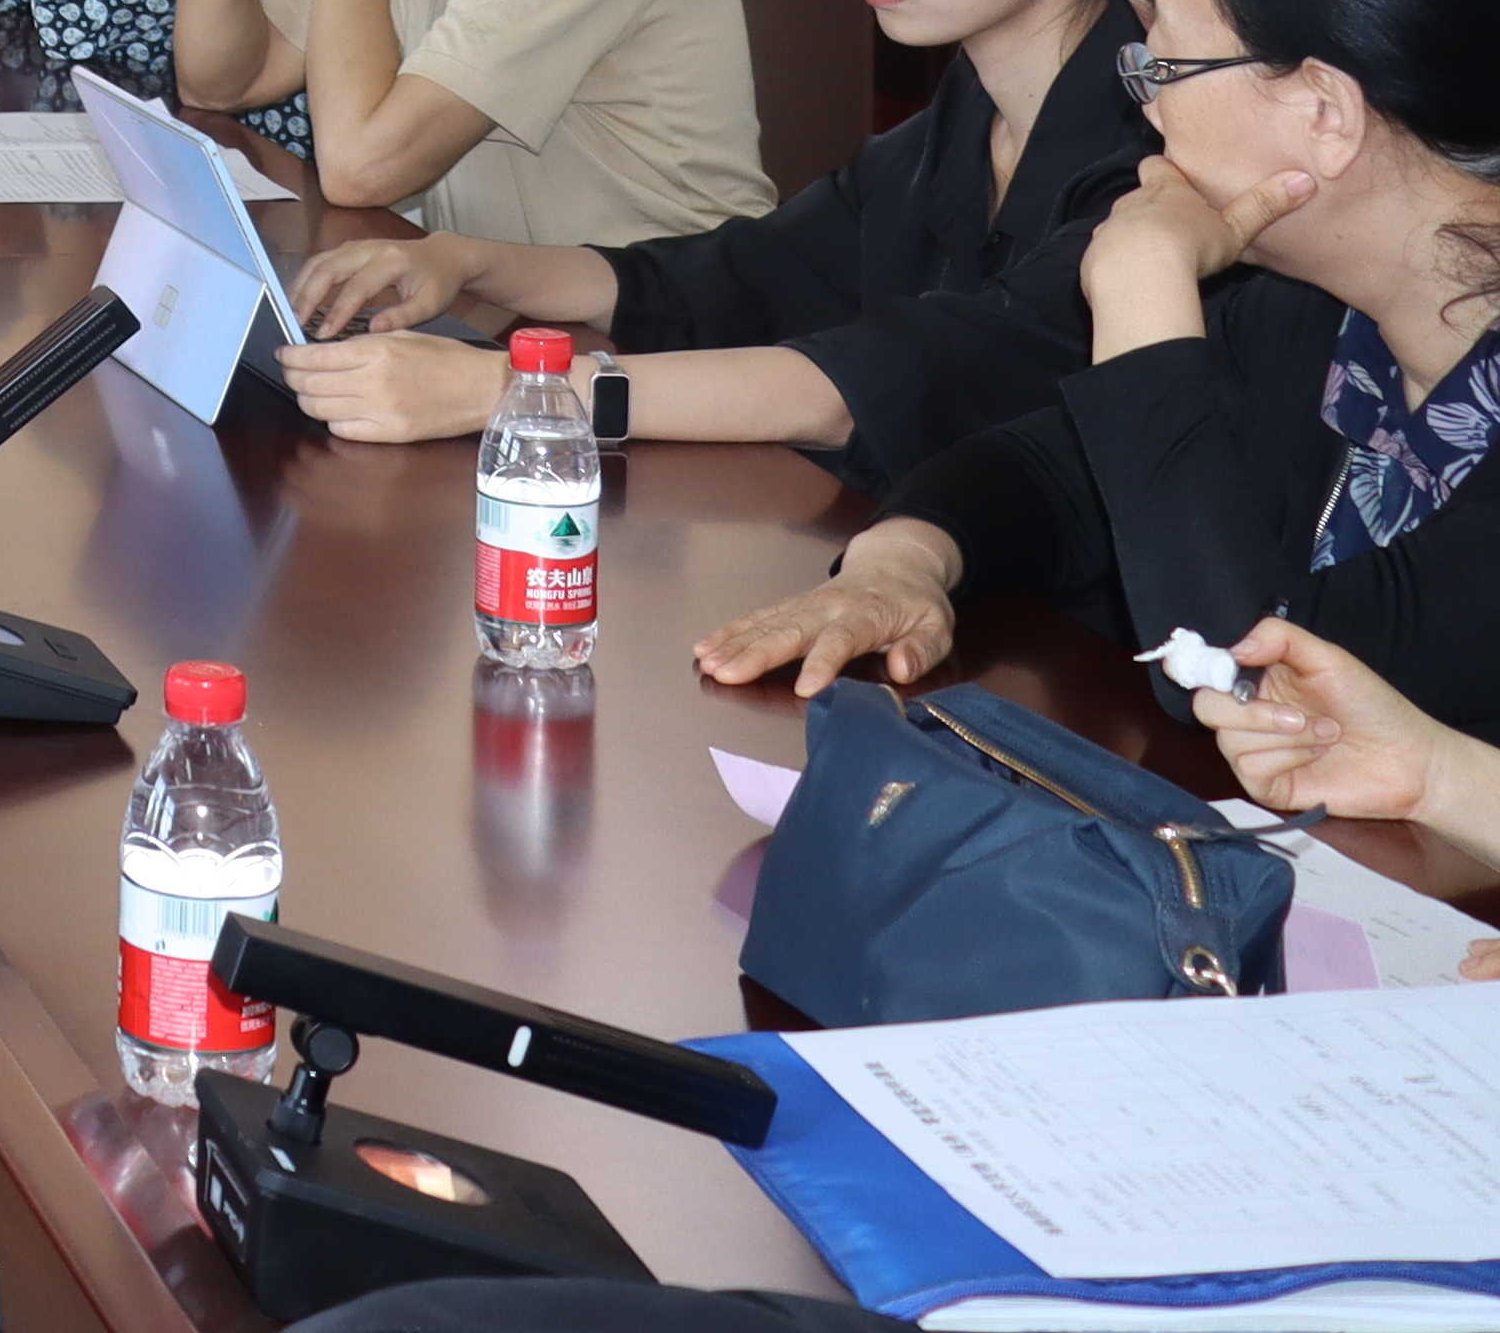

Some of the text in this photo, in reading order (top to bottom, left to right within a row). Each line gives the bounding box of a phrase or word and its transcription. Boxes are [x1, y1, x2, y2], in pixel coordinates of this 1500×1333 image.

[525, 564, 595, 588] 农夫山泉
[525, 588, 565, 600] NONGFU
